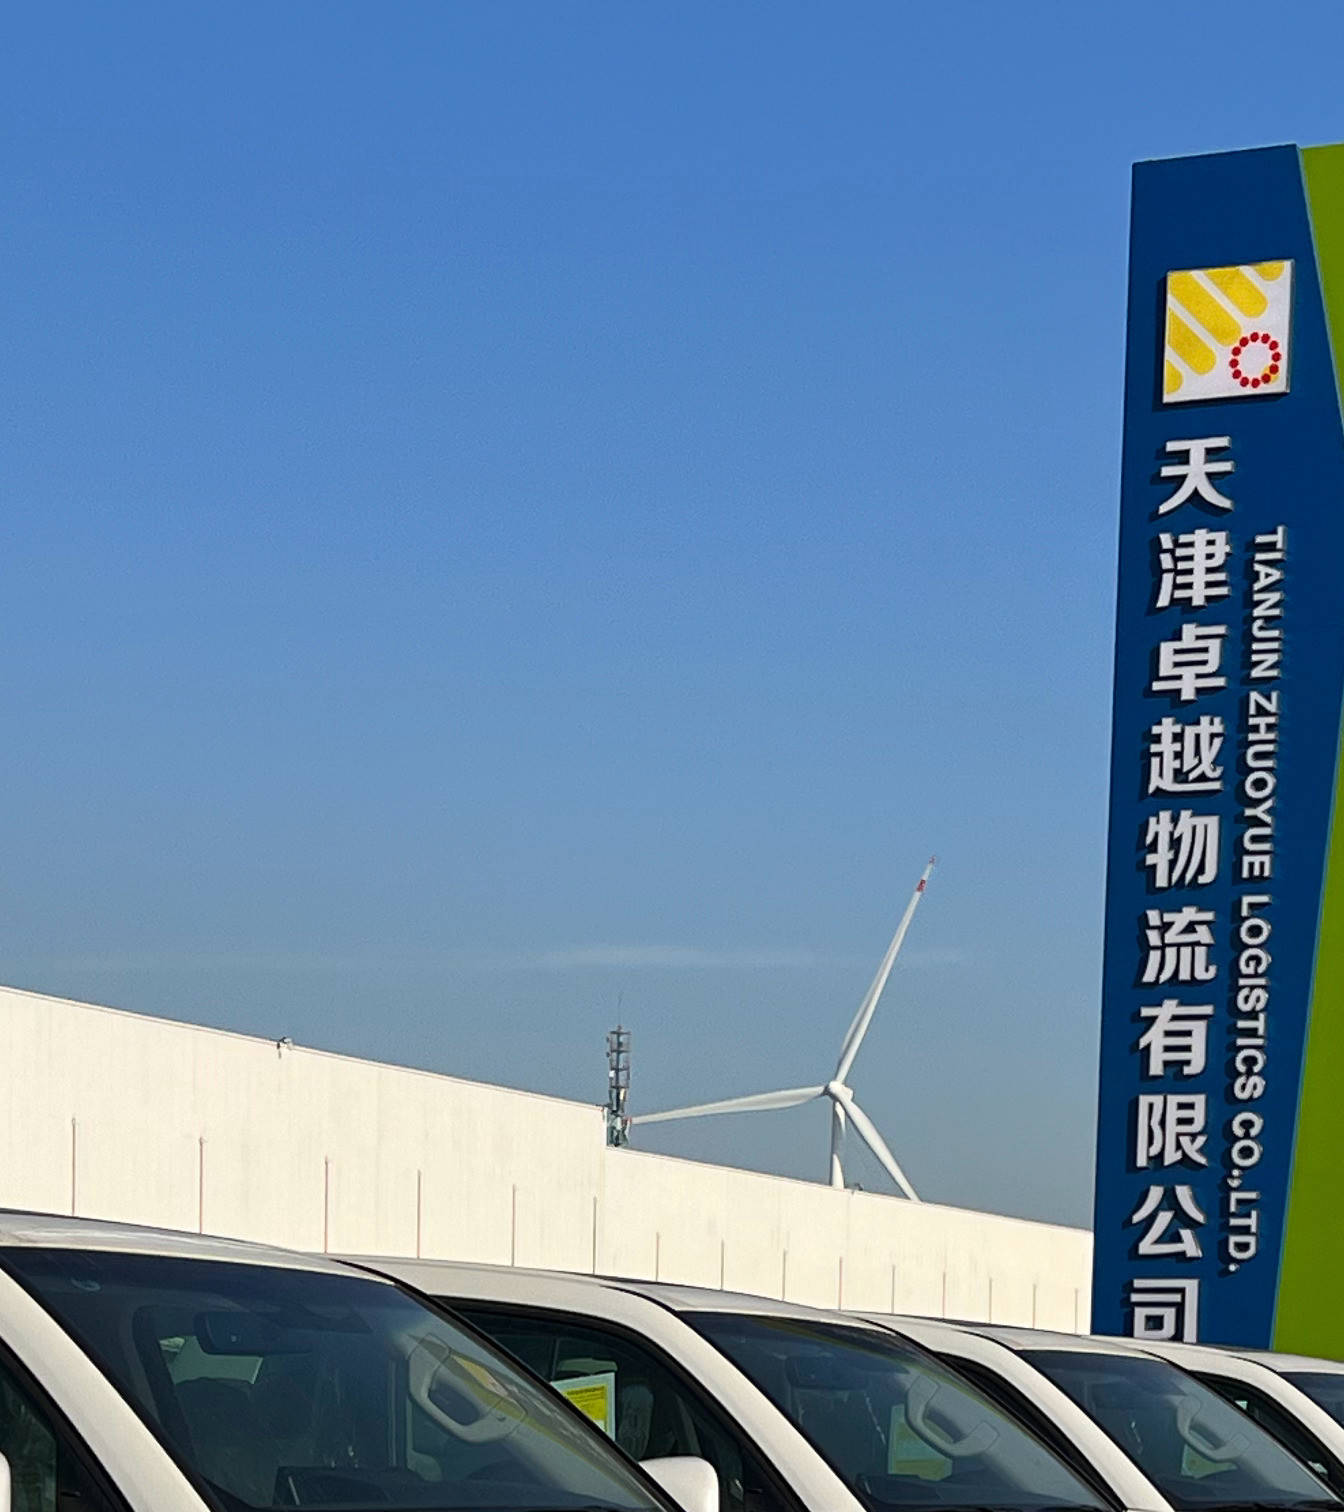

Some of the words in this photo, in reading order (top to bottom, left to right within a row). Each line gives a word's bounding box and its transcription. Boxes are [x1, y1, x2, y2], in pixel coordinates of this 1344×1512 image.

[1250, 525, 1288, 679] TIANJIN
[1241, 690, 1280, 879] ZHUOYUE
[1129, 435, 1237, 1344] 天津卓越物流有限公司
[1233, 894, 1272, 1101] LOGISTICS
